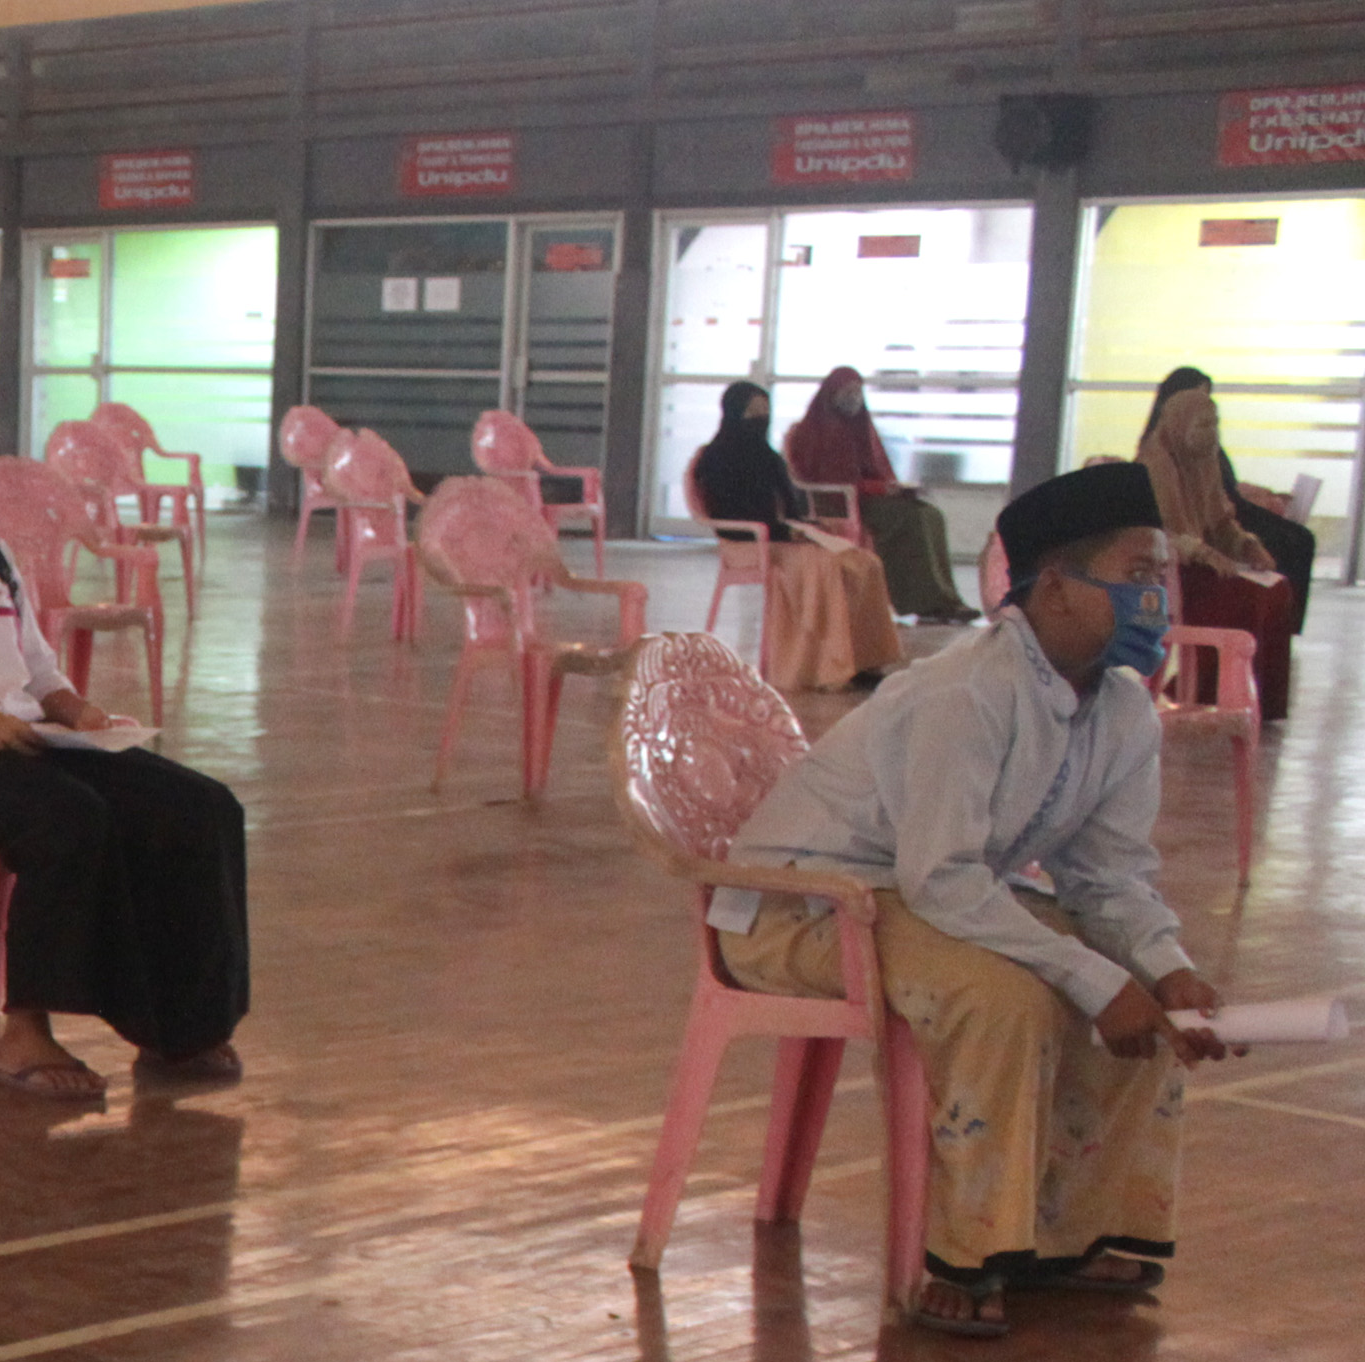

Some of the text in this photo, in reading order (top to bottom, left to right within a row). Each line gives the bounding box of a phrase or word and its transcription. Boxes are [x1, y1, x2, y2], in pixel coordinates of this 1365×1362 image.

[1249, 128, 1365, 154] Unipd
[795, 152, 907, 174] Unipdu
[417, 168, 508, 188] Unipdu
